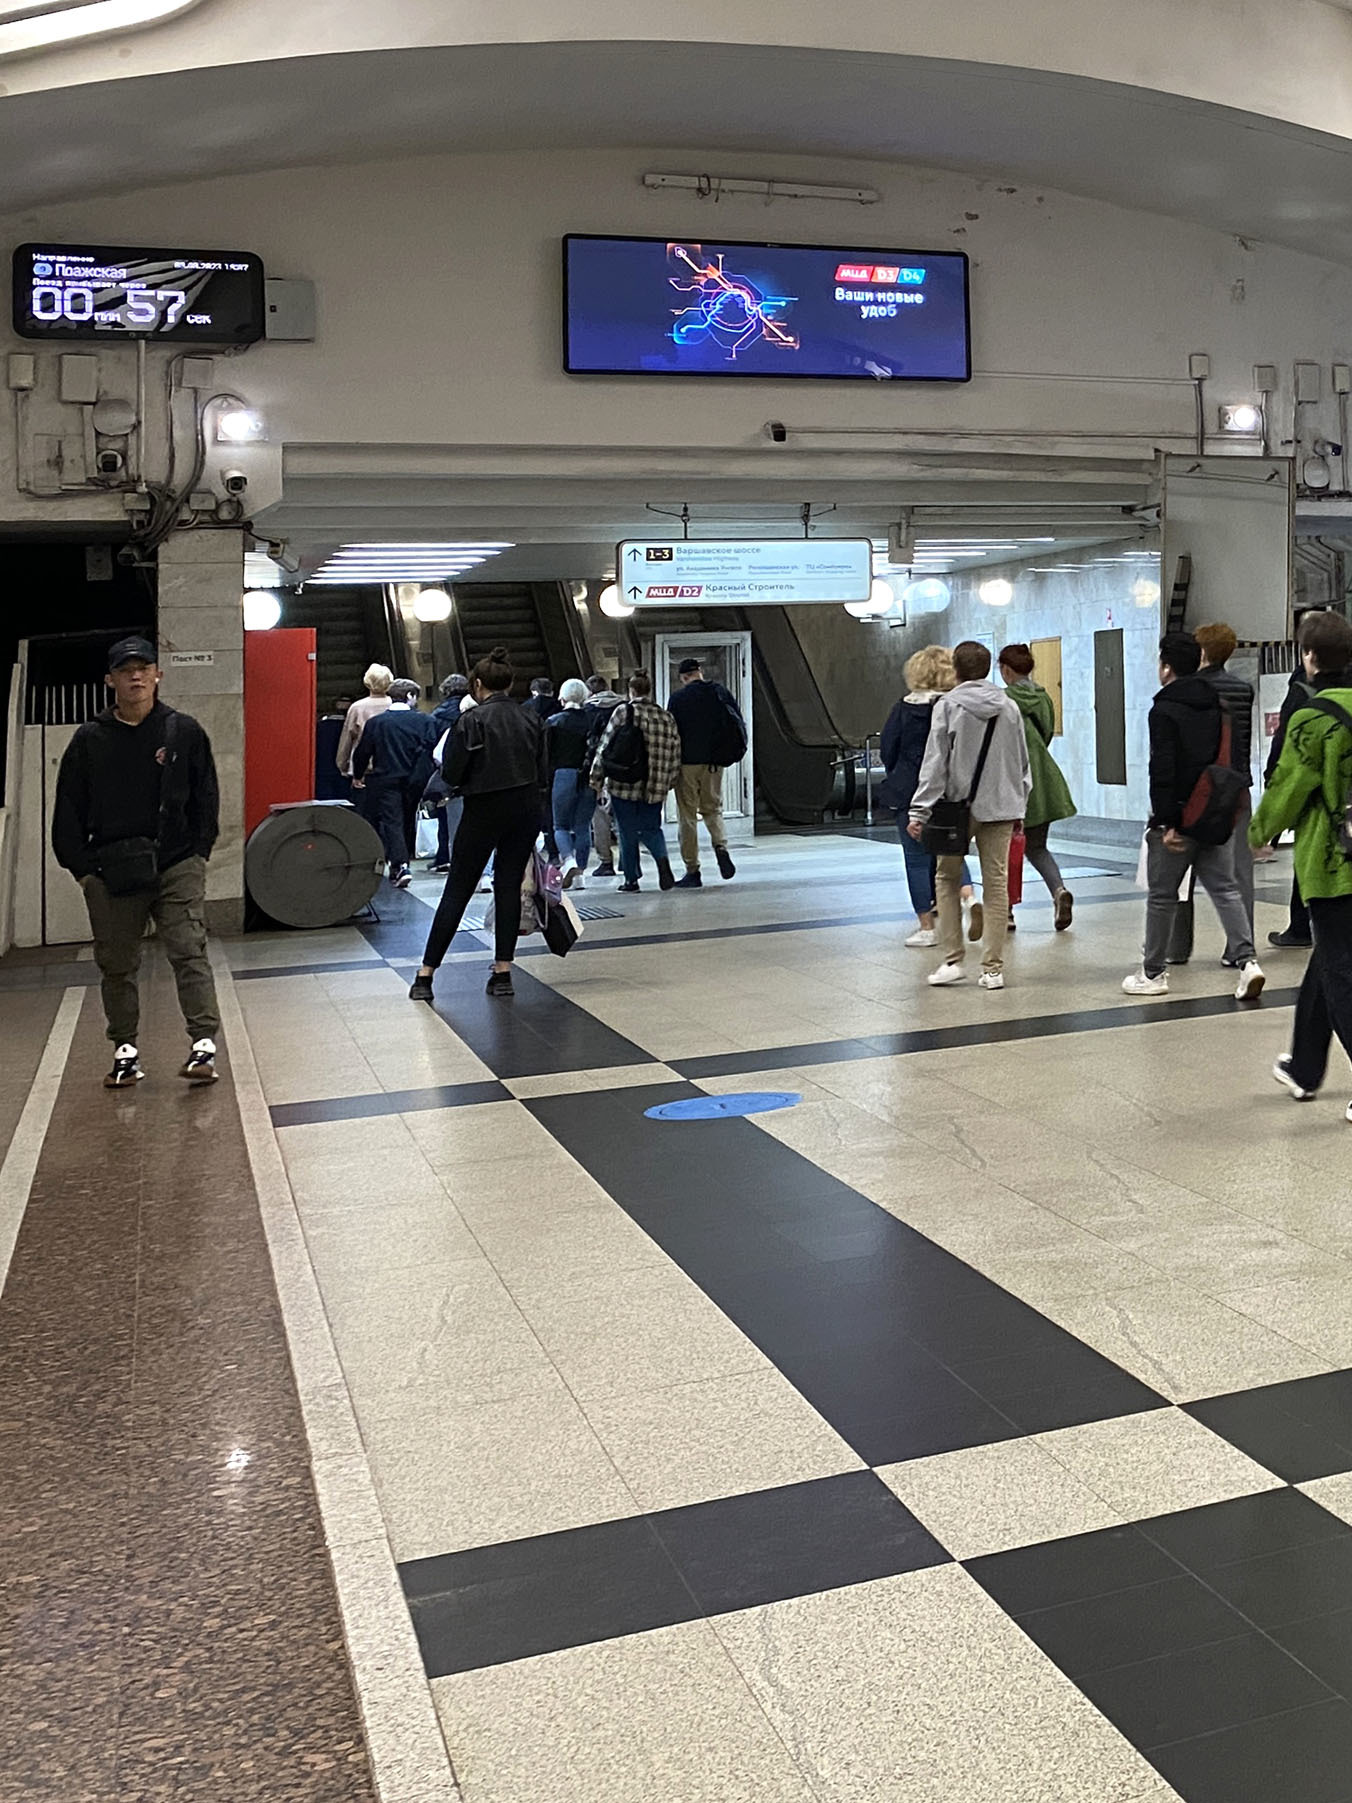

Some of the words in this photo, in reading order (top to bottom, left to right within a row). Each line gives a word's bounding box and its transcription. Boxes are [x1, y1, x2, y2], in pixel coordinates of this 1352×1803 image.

[876, 269, 895, 281] D3
[902, 270, 921, 281] D4
[32, 277, 63, 288] Поезд
[834, 286, 874, 303] Ваши
[876, 291, 925, 304] новые
[32, 286, 94, 321] 00
[126, 289, 186, 323] 57
[860, 303, 898, 320] удоб
[676, 546, 732, 556] Варшавское
[733, 547, 761, 555] шоссе
[681, 586, 700, 597] D2
[705, 582, 746, 593] Красный
[747, 582, 795, 593] Строитель
